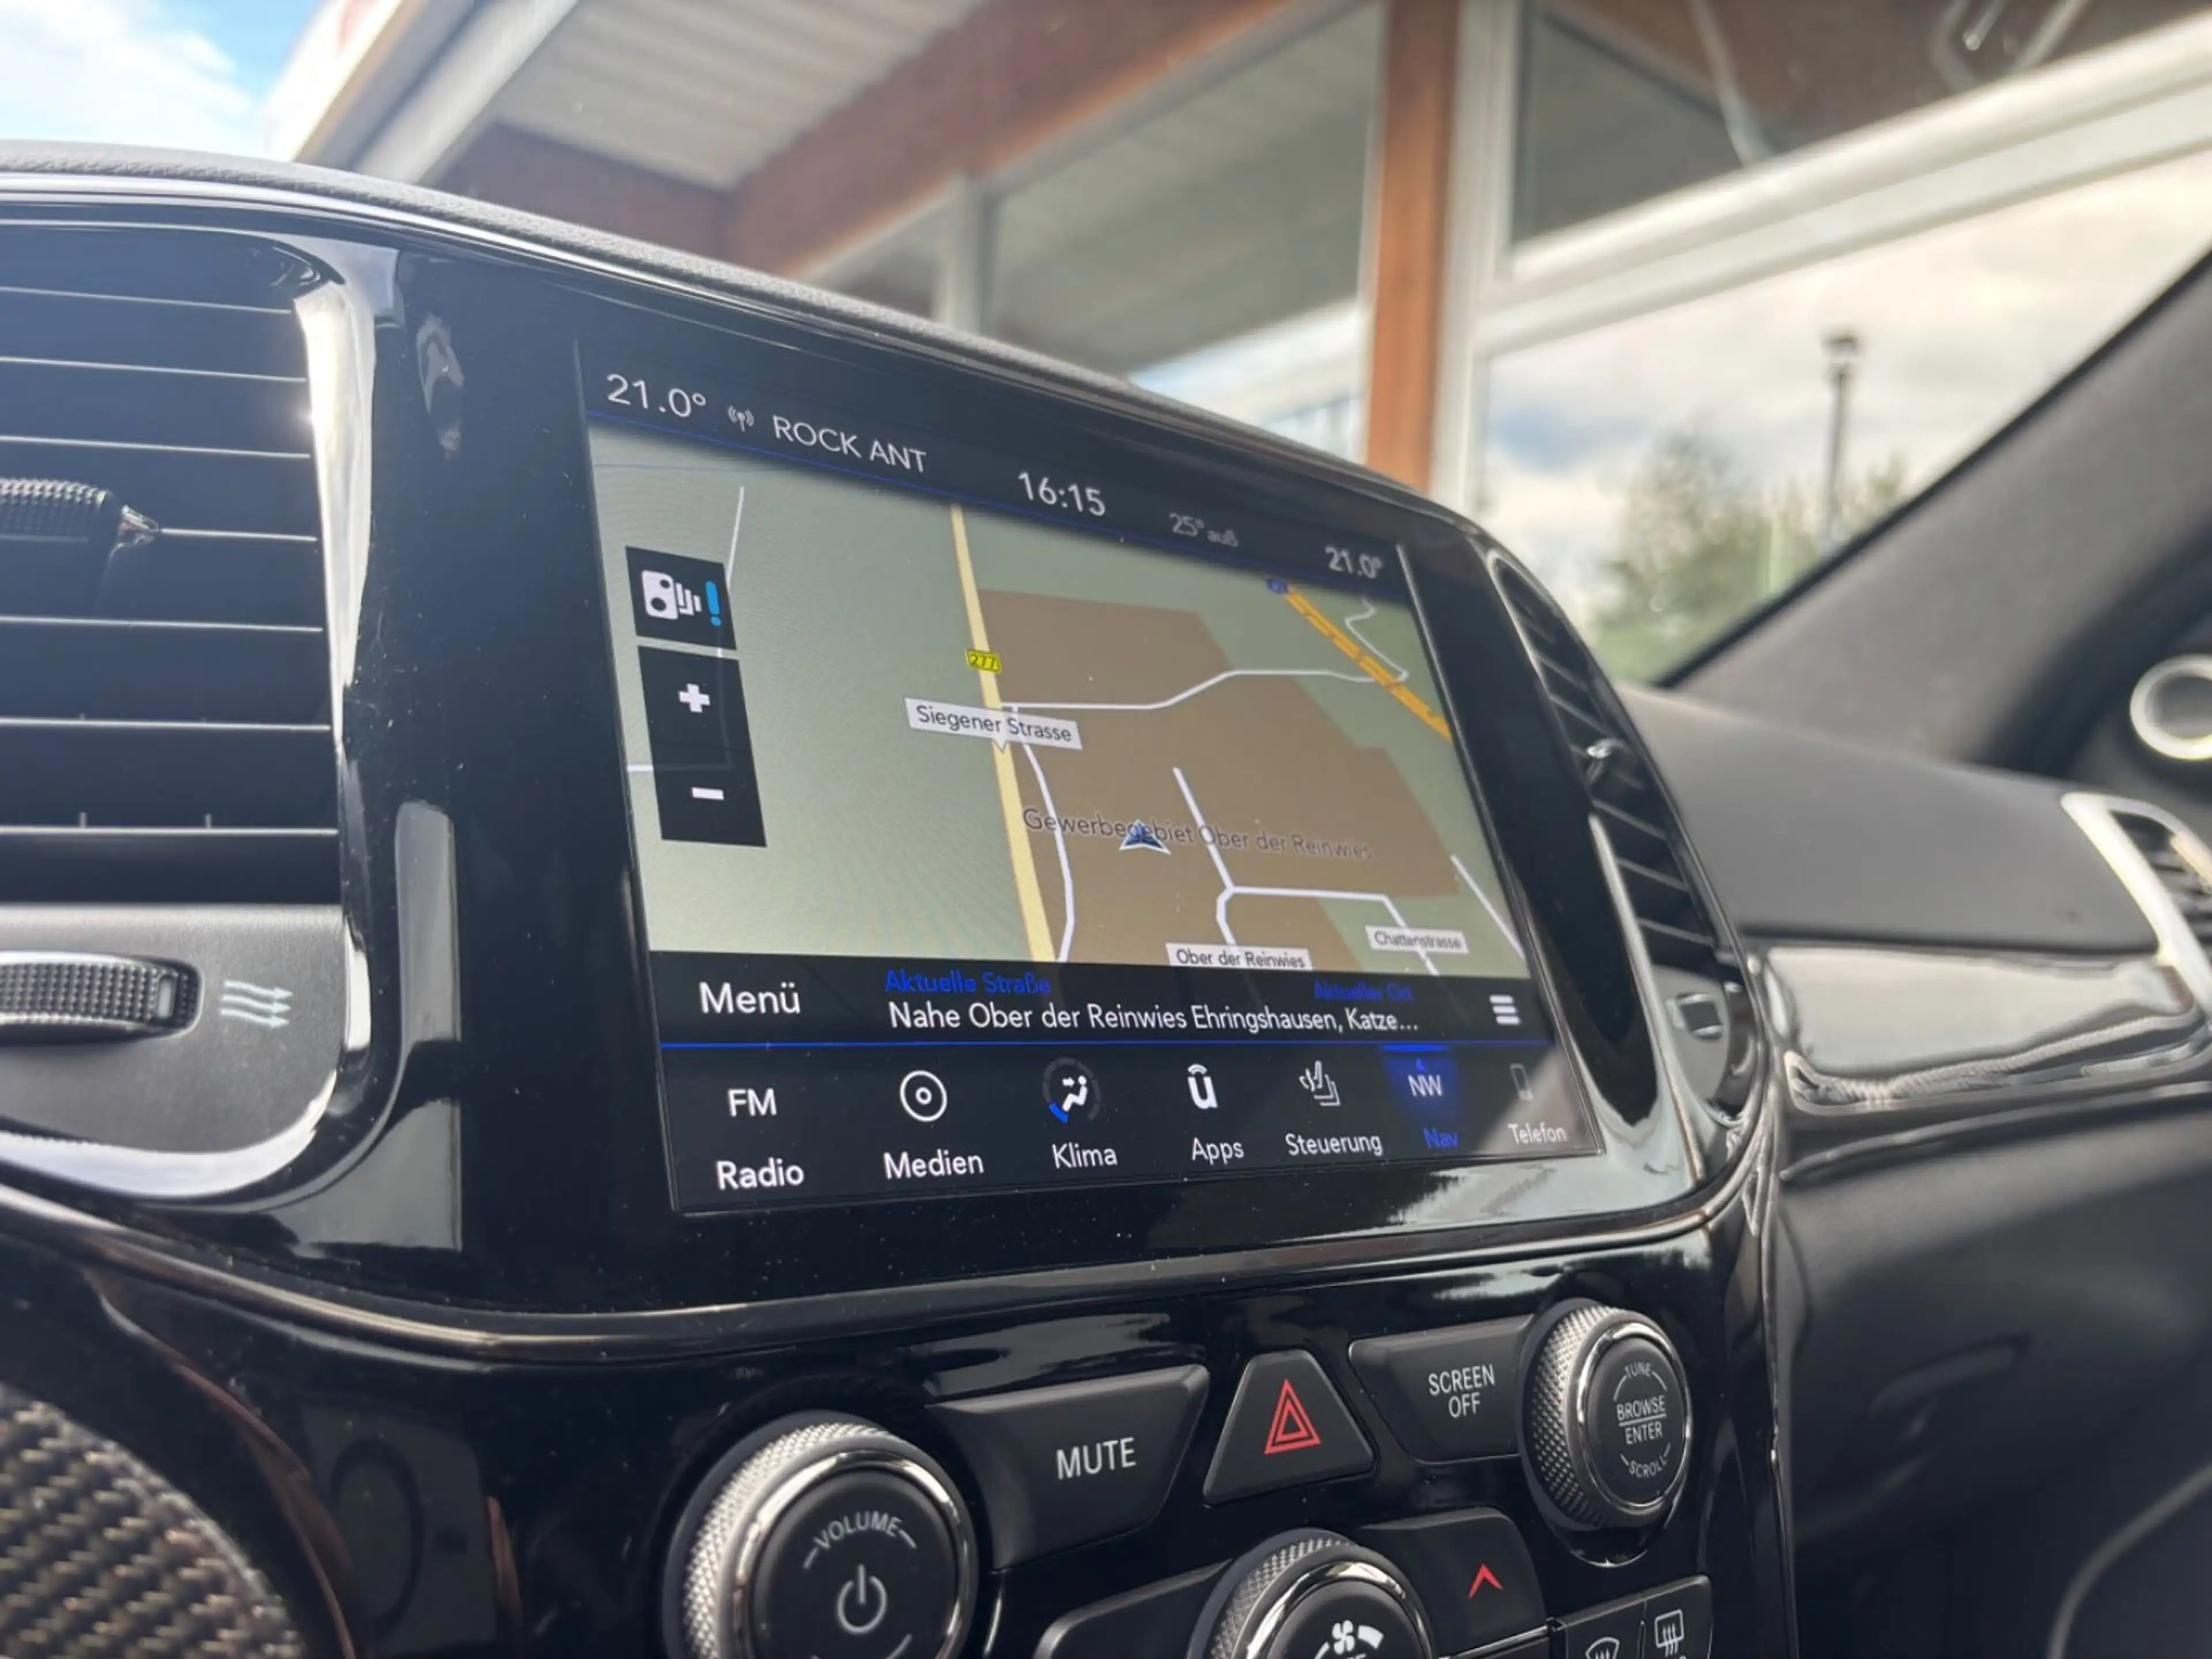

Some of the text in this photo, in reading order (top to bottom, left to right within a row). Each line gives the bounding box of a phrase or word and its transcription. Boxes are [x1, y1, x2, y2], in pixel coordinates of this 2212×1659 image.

[771, 414, 927, 473] ROCK ANT
[1018, 471, 1106, 516] 16:15
[969, 653, 997, 669] 277
[916, 704, 1072, 742] Siegener Strasse
[1198, 824, 1248, 848] Ober
[1256, 830, 1286, 853] der
[1176, 949, 1306, 969] Ober der Reinwies
[885, 969, 1053, 995] Aktuelle Straße
[698, 981, 801, 1014] Menü
[889, 1001, 961, 1028] Nahe
[968, 1002, 1033, 1028] Ober
[1041, 1002, 1081, 1028] der
[1087, 1003, 1187, 1029] Reinwies
[1191, 1005, 1344, 1033] Ehringshausen,
[1407, 1075, 1442, 1097] NW
[728, 1089, 777, 1117] FM
[1285, 1134, 1382, 1156] Steuerung
[1424, 1128, 1459, 1148] Nav
[1508, 1121, 1568, 1146] Telefon
[1052, 1142, 1118, 1169] Klima
[1191, 1137, 1245, 1164] Apps
[716, 1157, 805, 1191] Radio
[883, 1150, 984, 1181] Medien
[1428, 1364, 1495, 1396] SCREEN
[1626, 1361, 1652, 1378] TUNE
[1448, 1392, 1480, 1419] OFF
[1616, 1395, 1666, 1420] BROWSE
[1624, 1421, 1663, 1445] ENTER
[1056, 1437, 1136, 1480] MUTE
[1629, 1457, 1668, 1479] SCROLL
[813, 1510, 904, 1552] VOLUME
